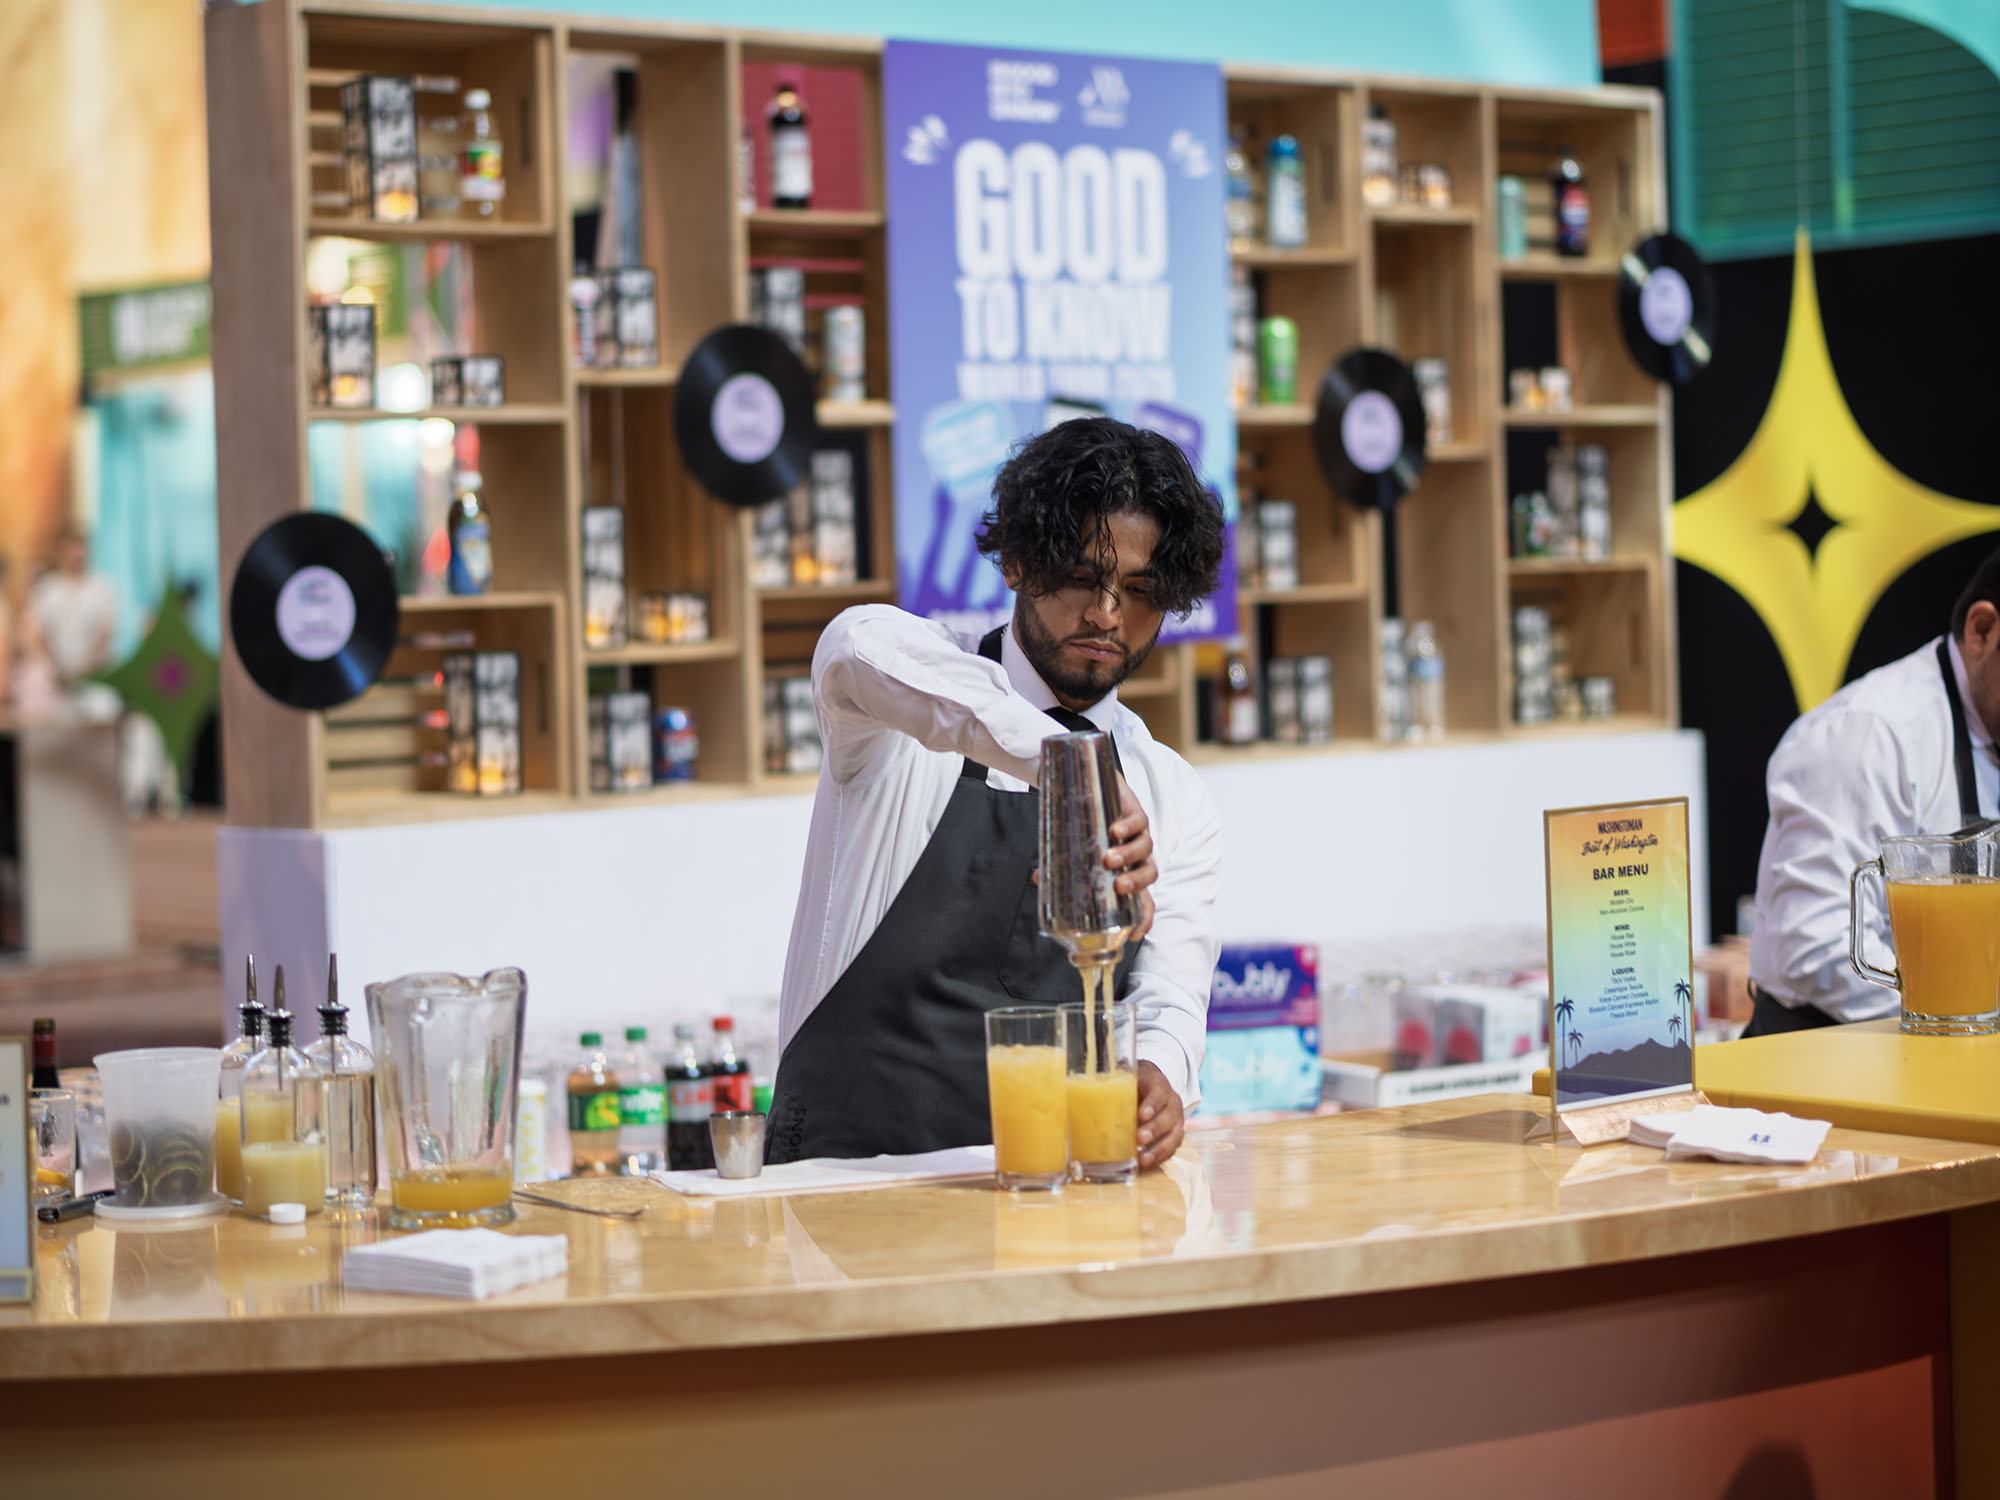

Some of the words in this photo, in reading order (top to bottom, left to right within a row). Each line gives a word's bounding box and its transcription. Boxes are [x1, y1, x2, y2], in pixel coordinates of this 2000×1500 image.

[953, 138, 1168, 285] GOOD
[957, 277, 1019, 362] TO
[1023, 282, 1172, 362] KNOW
[1582, 840, 1603, 856] Best
[1603, 837, 1613, 856] of
[1613, 834, 1658, 855] Washington
[1593, 867, 1615, 880] BAR
[1618, 864, 1649, 878] MENU
